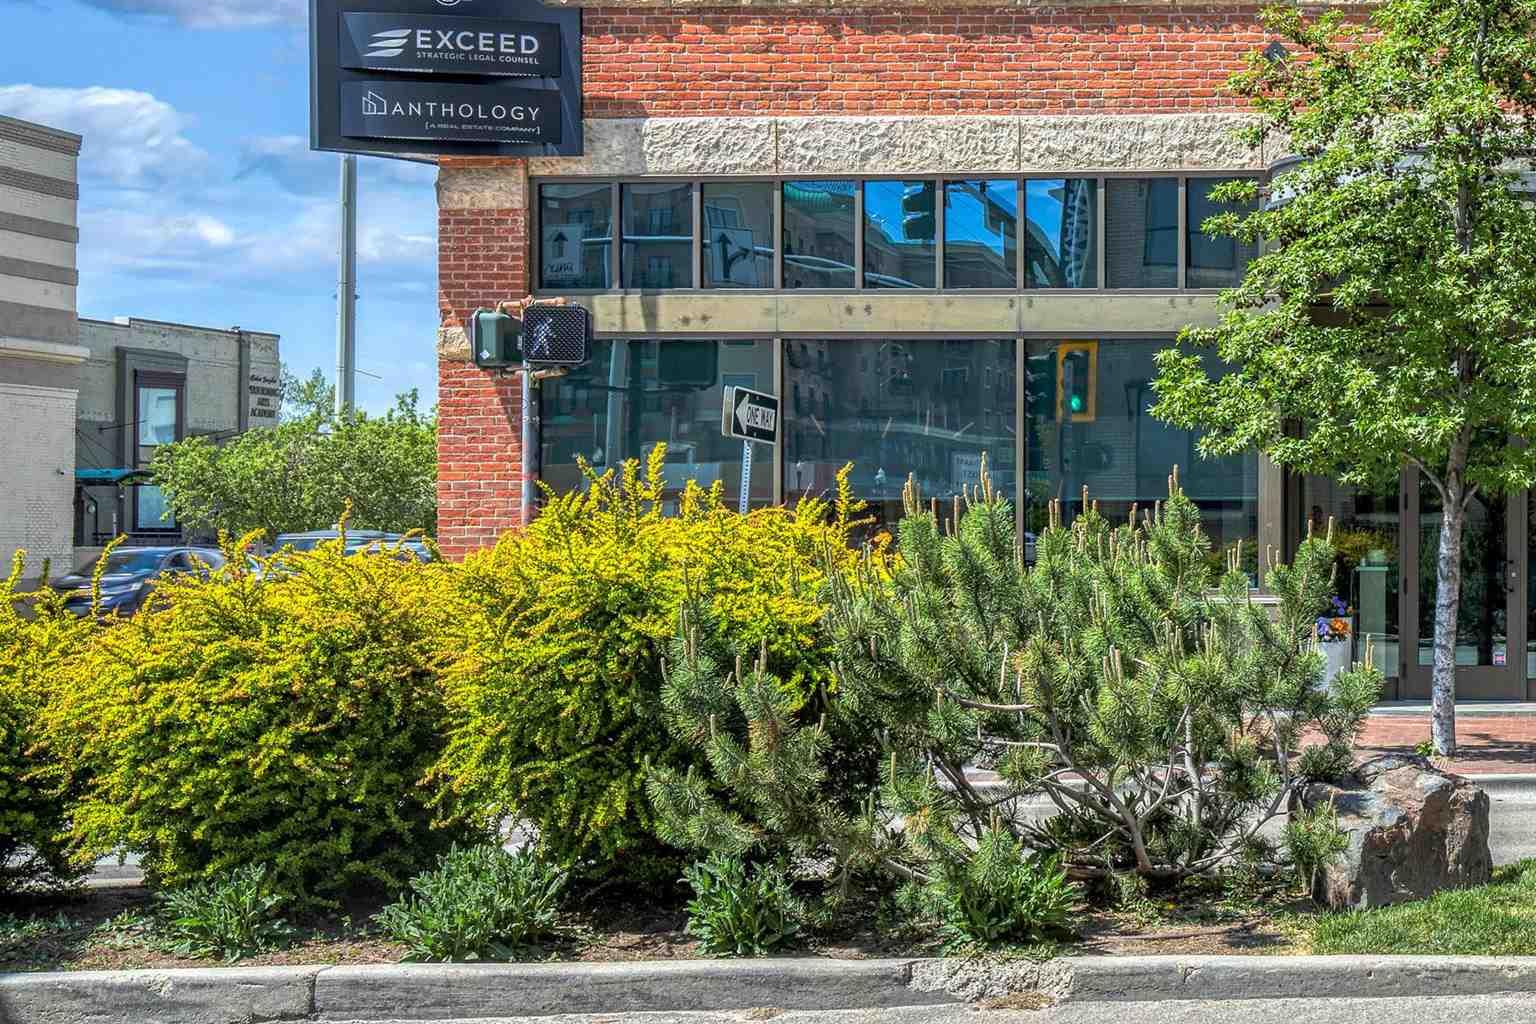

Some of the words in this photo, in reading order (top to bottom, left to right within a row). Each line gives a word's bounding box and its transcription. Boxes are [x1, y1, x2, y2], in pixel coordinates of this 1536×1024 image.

[416, 29, 540, 54] EXCEED
[416, 51, 465, 61] STRATEGIC
[469, 53, 496, 63] LEGAL
[499, 55, 540, 65] COUNSEL
[392, 101, 540, 121] ANTHOLOGY
[747, 406, 760, 426] ONE
[760, 408, 774, 429] WAY
